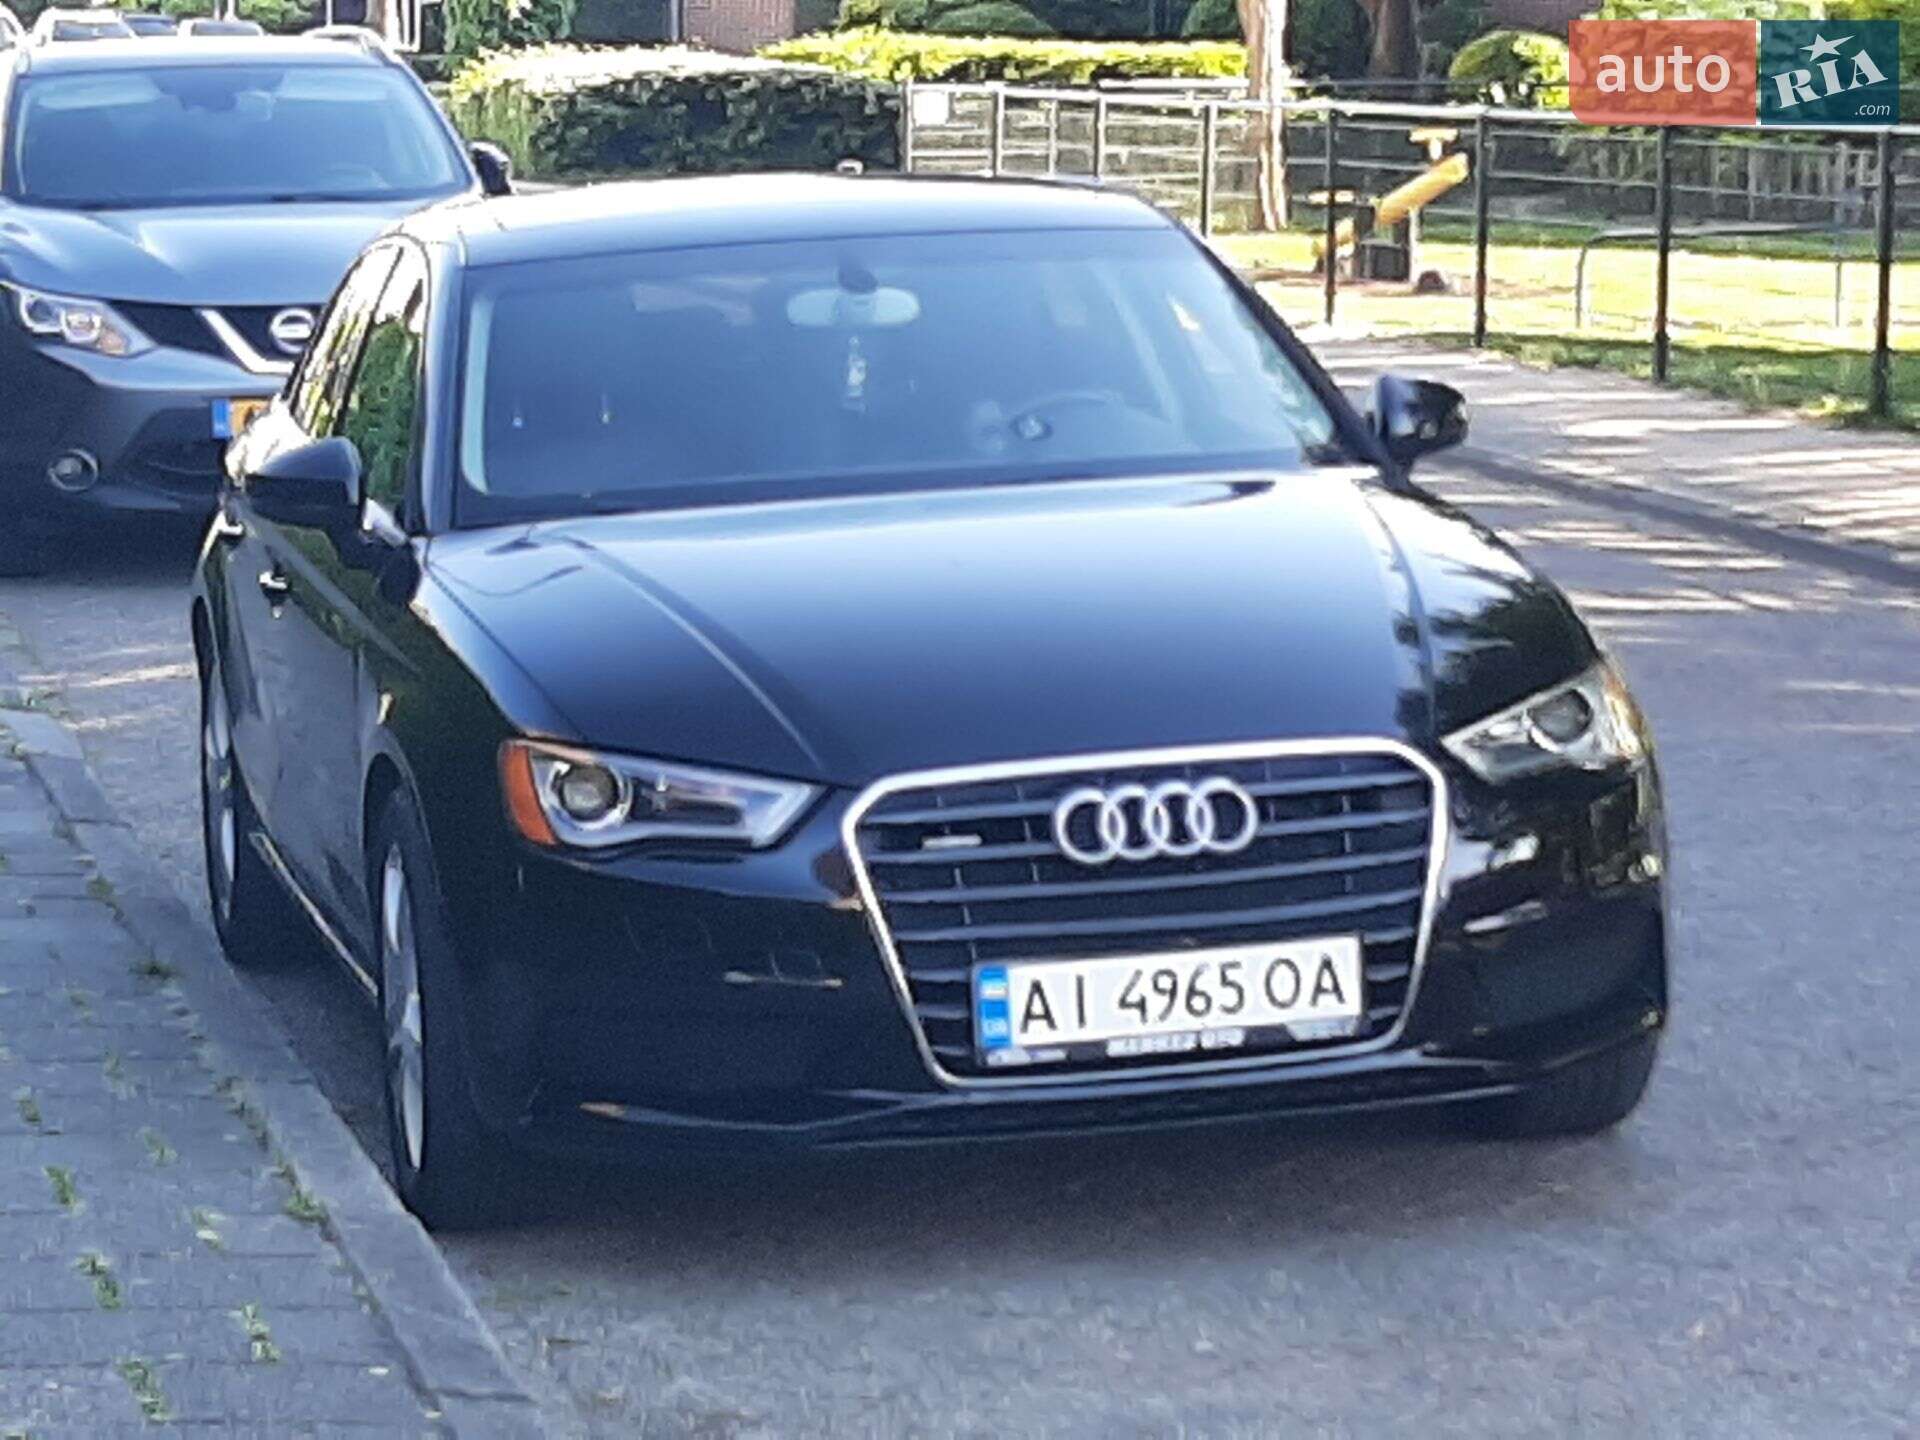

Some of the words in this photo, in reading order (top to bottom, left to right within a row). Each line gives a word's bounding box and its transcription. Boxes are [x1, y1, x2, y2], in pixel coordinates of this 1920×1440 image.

[1020, 975, 1087, 1033] AI
[1117, 961, 1245, 1023] 4965
[1264, 954, 1345, 1009] OA
